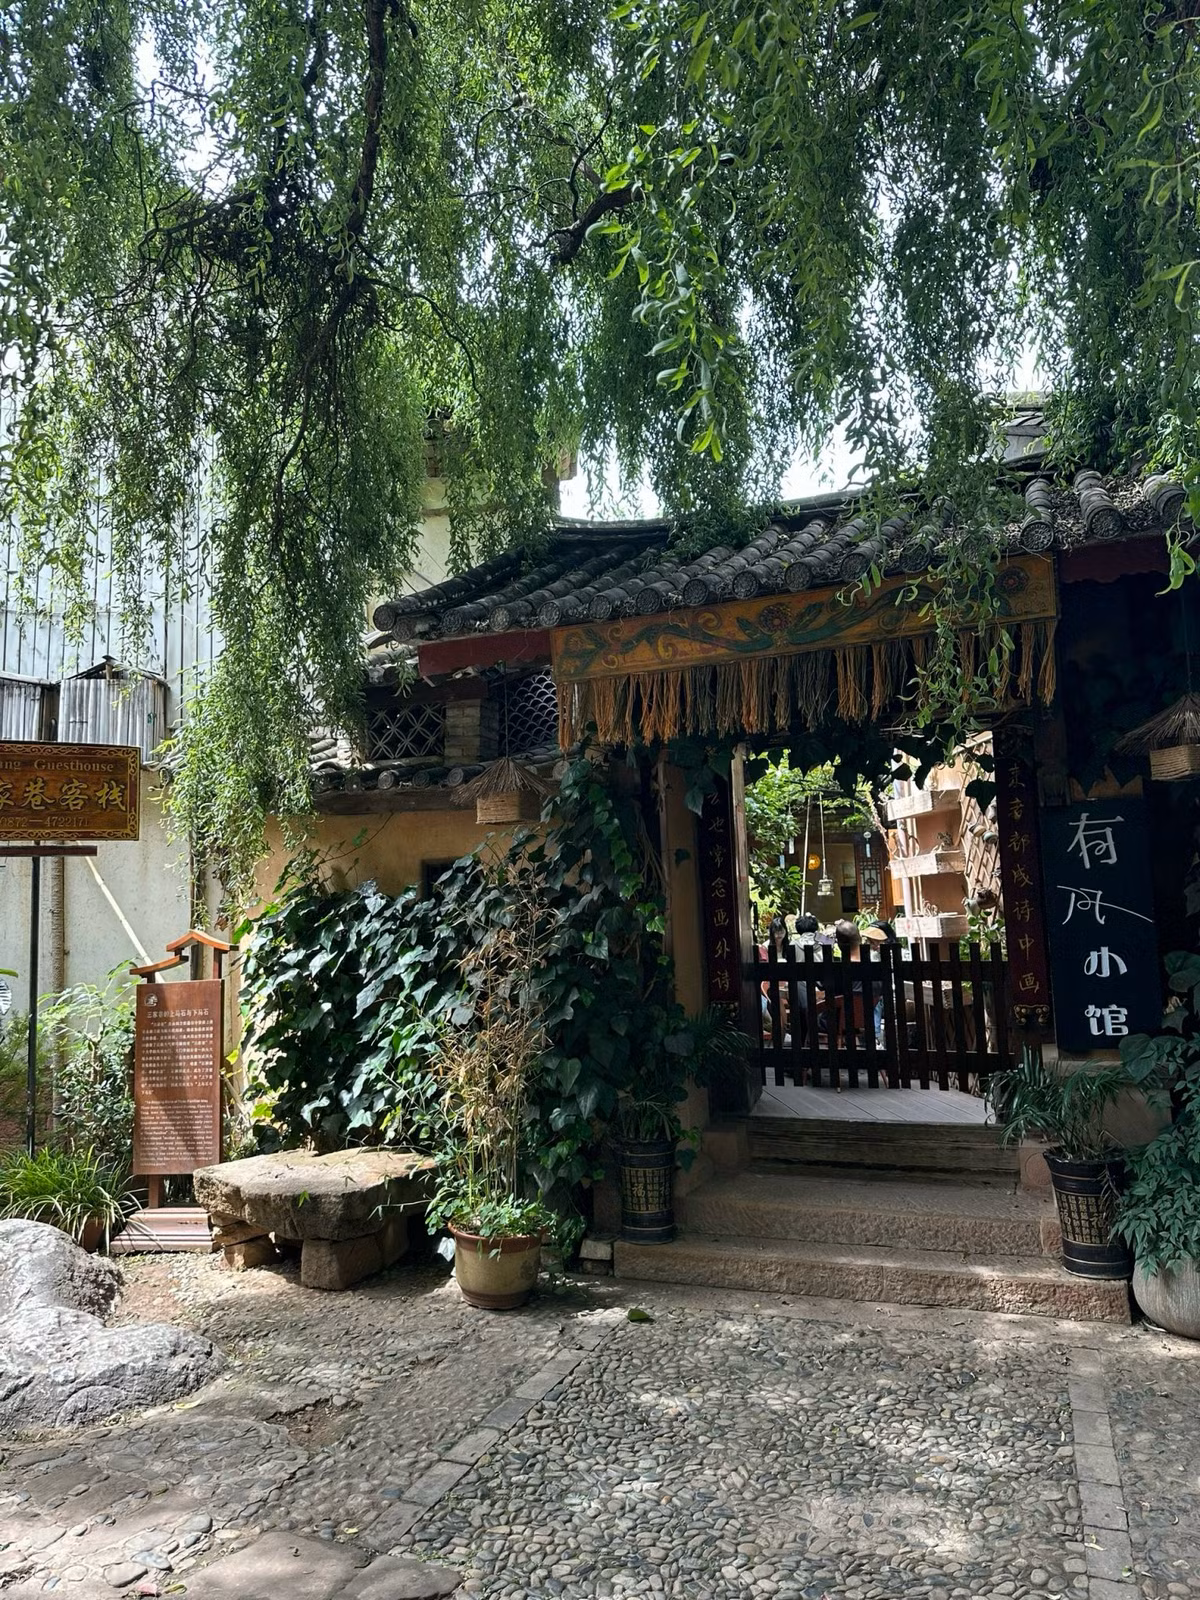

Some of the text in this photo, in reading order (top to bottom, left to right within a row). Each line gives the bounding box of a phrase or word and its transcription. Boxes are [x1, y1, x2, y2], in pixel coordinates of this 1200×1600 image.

[0, 758, 114, 772] ng Guesthouse
[1057, 812, 1155, 1037] 有风小馆
